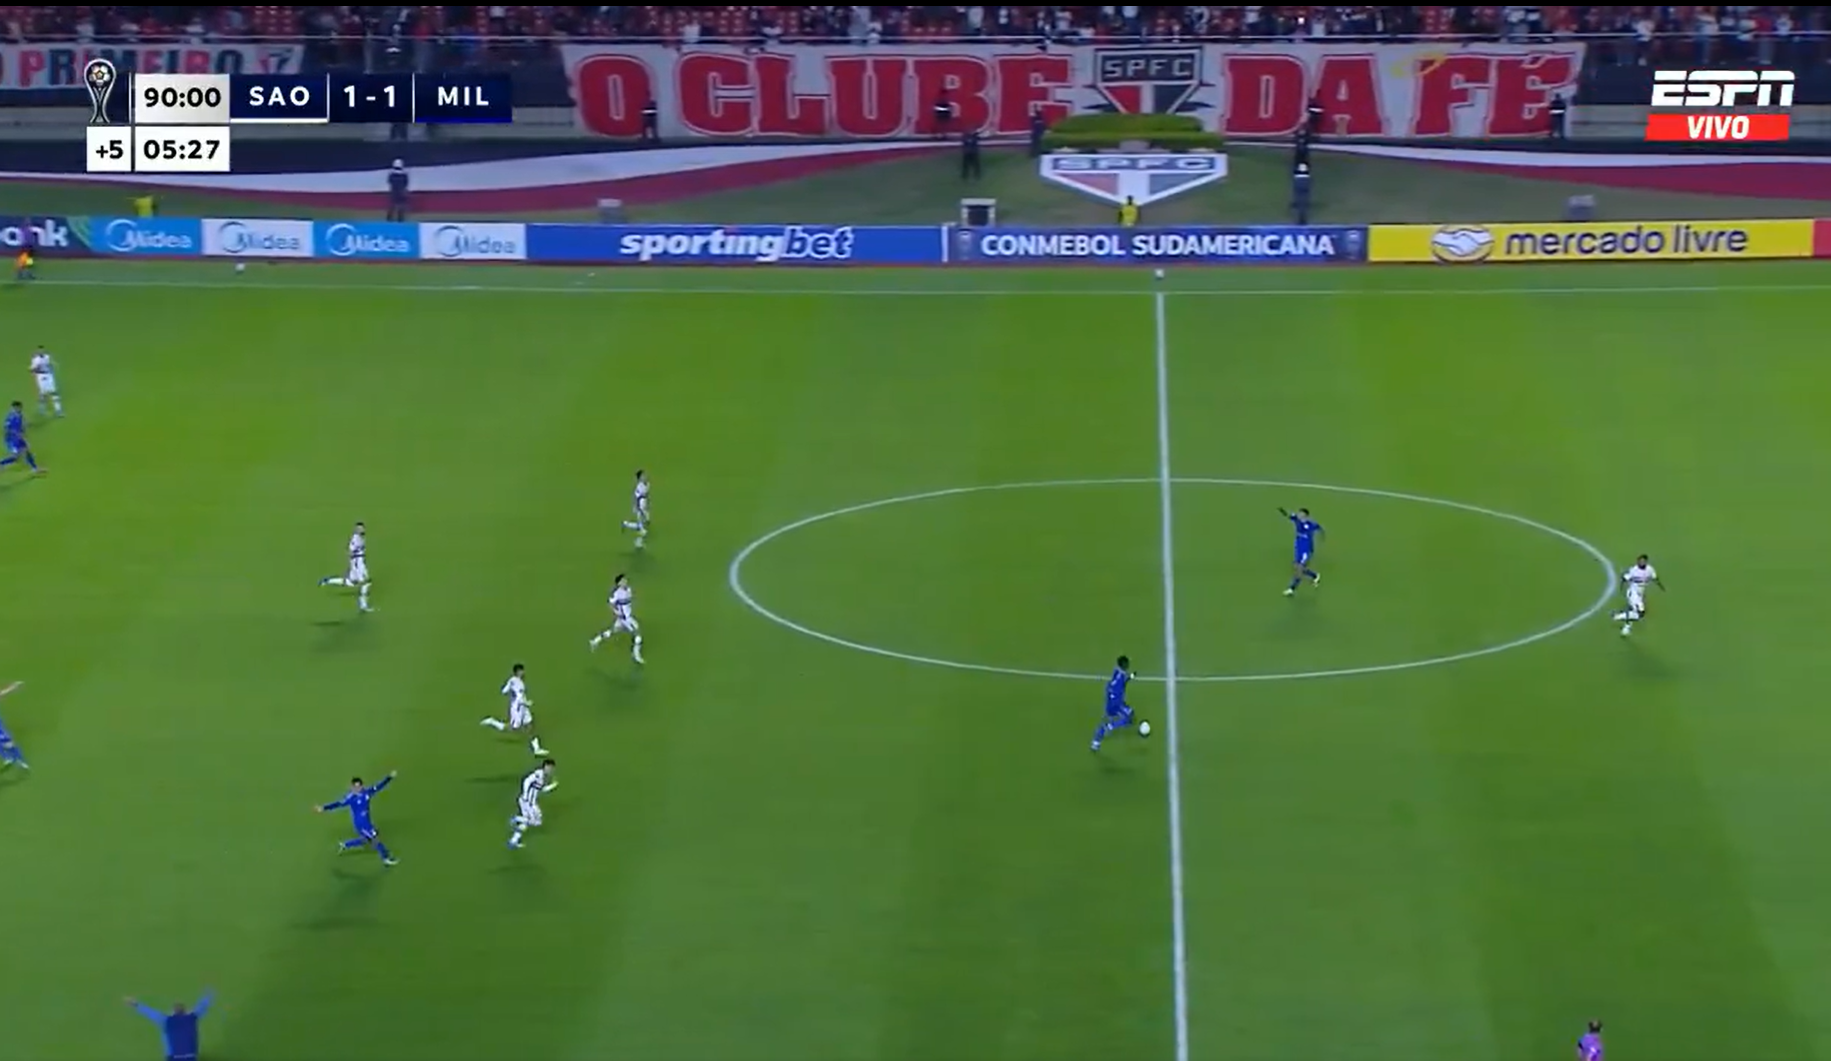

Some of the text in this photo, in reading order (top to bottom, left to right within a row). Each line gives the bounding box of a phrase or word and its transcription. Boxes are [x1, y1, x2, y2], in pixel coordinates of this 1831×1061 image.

[1104, 58, 1193, 77] SPFC
[576, 54, 656, 137] O
[676, 52, 1072, 136] CLUBE
[1224, 54, 1388, 137] DA
[1057, 156, 1214, 170] SPFC
[122, 229, 192, 249] Midea
[341, 233, 410, 253] Midea
[453, 235, 516, 254] Midea
[619, 225, 854, 262] sportingbet
[981, 233, 1335, 256] CONMEBOL SUDAMERICANA
[1505, 224, 1748, 256] mercado livre
